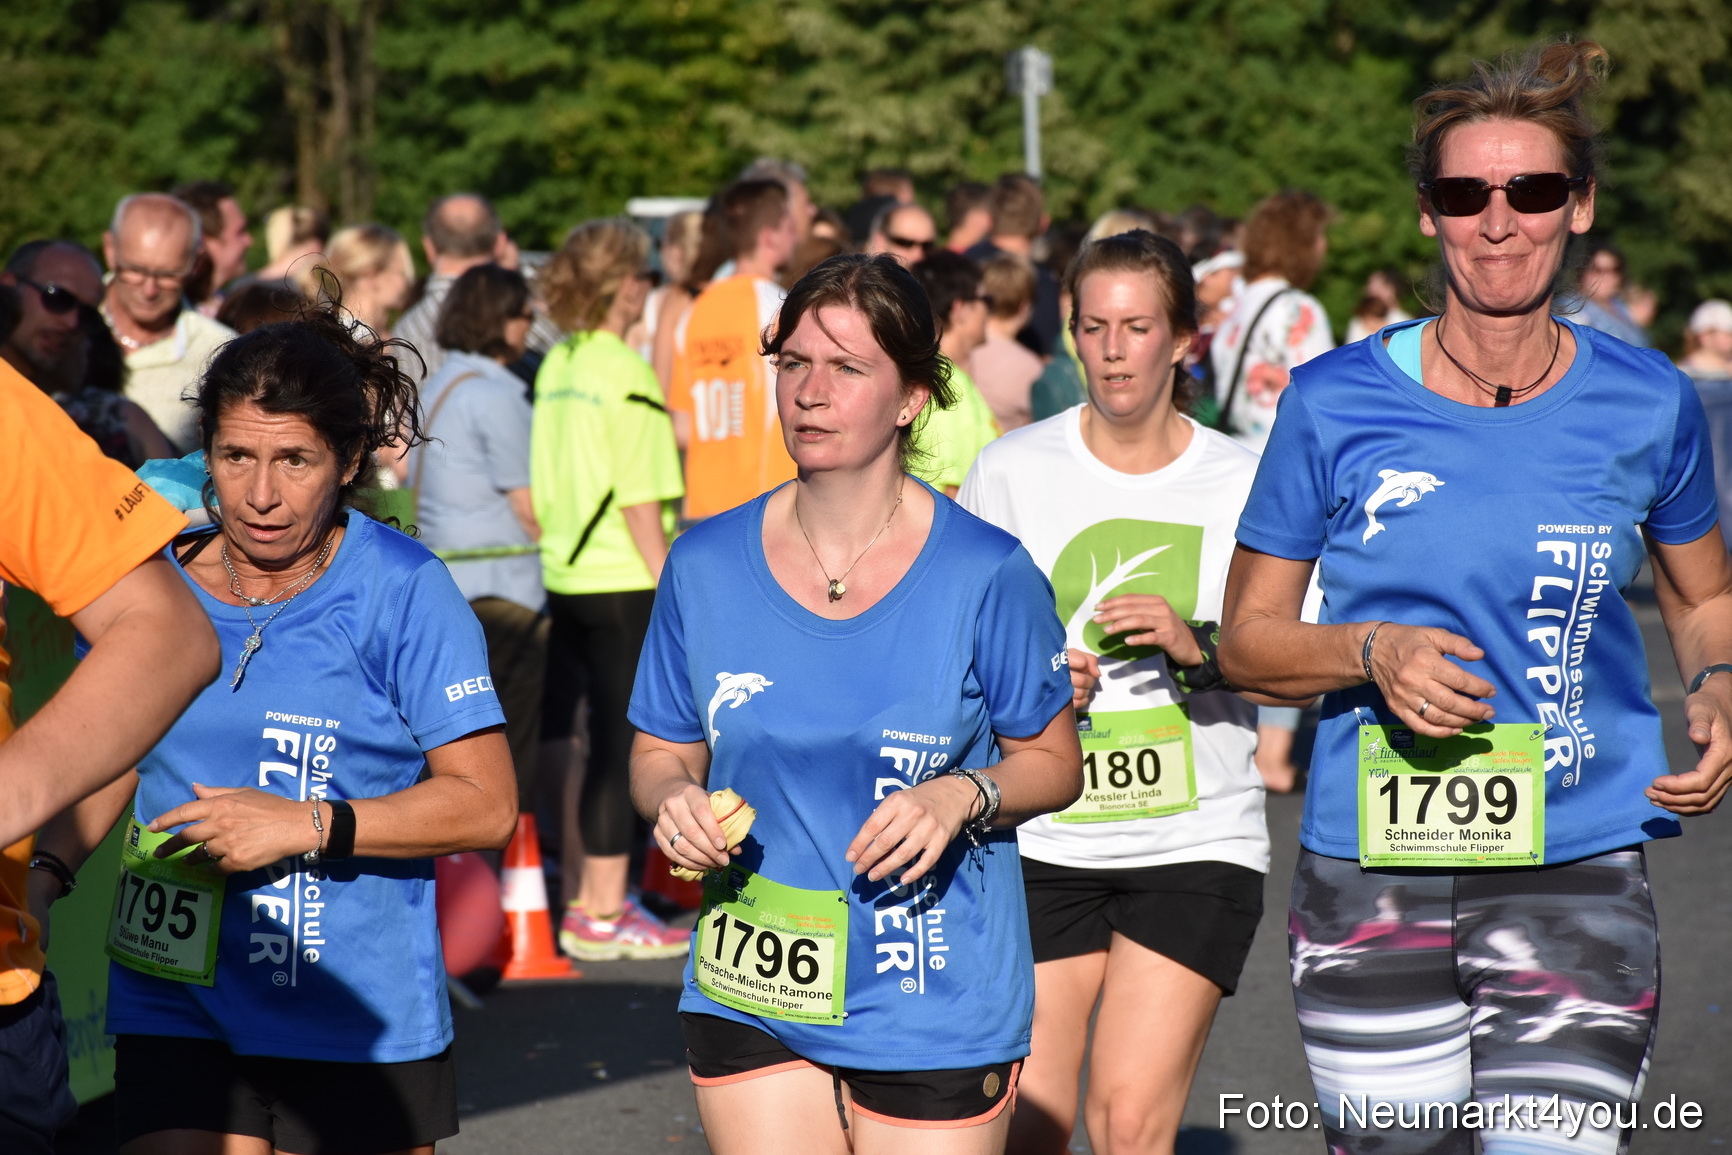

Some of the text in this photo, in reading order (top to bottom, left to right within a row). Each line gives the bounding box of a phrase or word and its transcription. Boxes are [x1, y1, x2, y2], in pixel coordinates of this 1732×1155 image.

[689, 378, 728, 441] 10
[1537, 524, 1612, 534] POWERED BY
[1526, 540, 1576, 772] FLIPPER
[1569, 541, 1612, 759] Schwimmschule
[265, 711, 341, 729] POWERED BY
[882, 729, 952, 746] POWERED BY
[1118, 734, 1145, 745] 2018
[1083, 748, 1161, 790] 180
[1085, 788, 1162, 802] Kessler Linda
[1099, 800, 1149, 811] Bionorica SE
[1379, 775, 1518, 825] 1799
[1385, 829, 1512, 841] Schneider Monika
[1389, 843, 1505, 854] Schwimmschule Flipper
[117, 870, 199, 940] 1795
[759, 911, 787, 927] 2018
[119, 925, 169, 952] Stüwe Manu
[712, 912, 820, 985] 1796
[150, 952, 179, 966] Flipper
[699, 956, 776, 993] Persache-Mielich
[779, 985, 833, 1001] Ramone
[710, 978, 769, 1005] Schwimmschule
[771, 997, 804, 1010] Flipper
